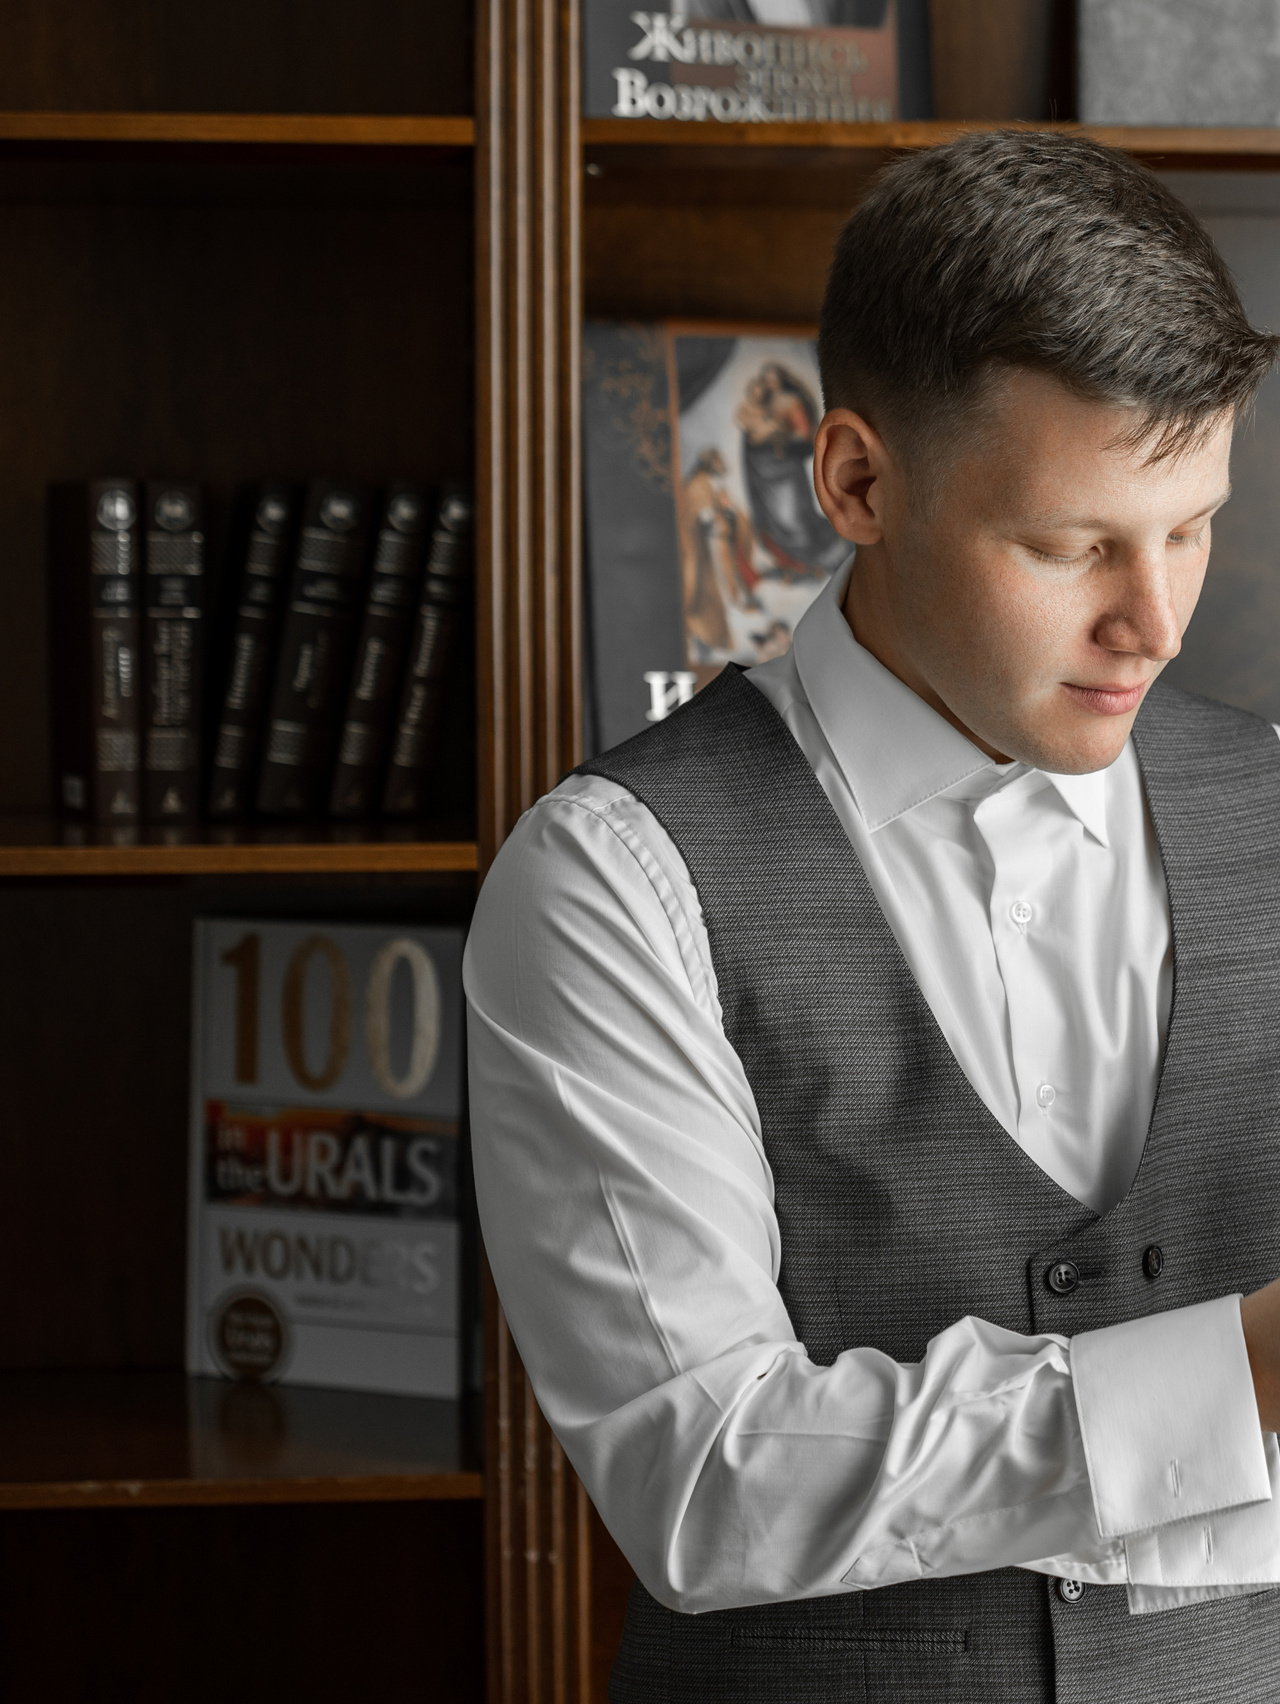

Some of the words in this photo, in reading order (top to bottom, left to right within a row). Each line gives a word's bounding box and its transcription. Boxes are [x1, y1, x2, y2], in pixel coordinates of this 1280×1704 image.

[219, 933, 441, 1099] 100
[216, 1158, 264, 1194] the
[266, 1127, 441, 1206] URALS
